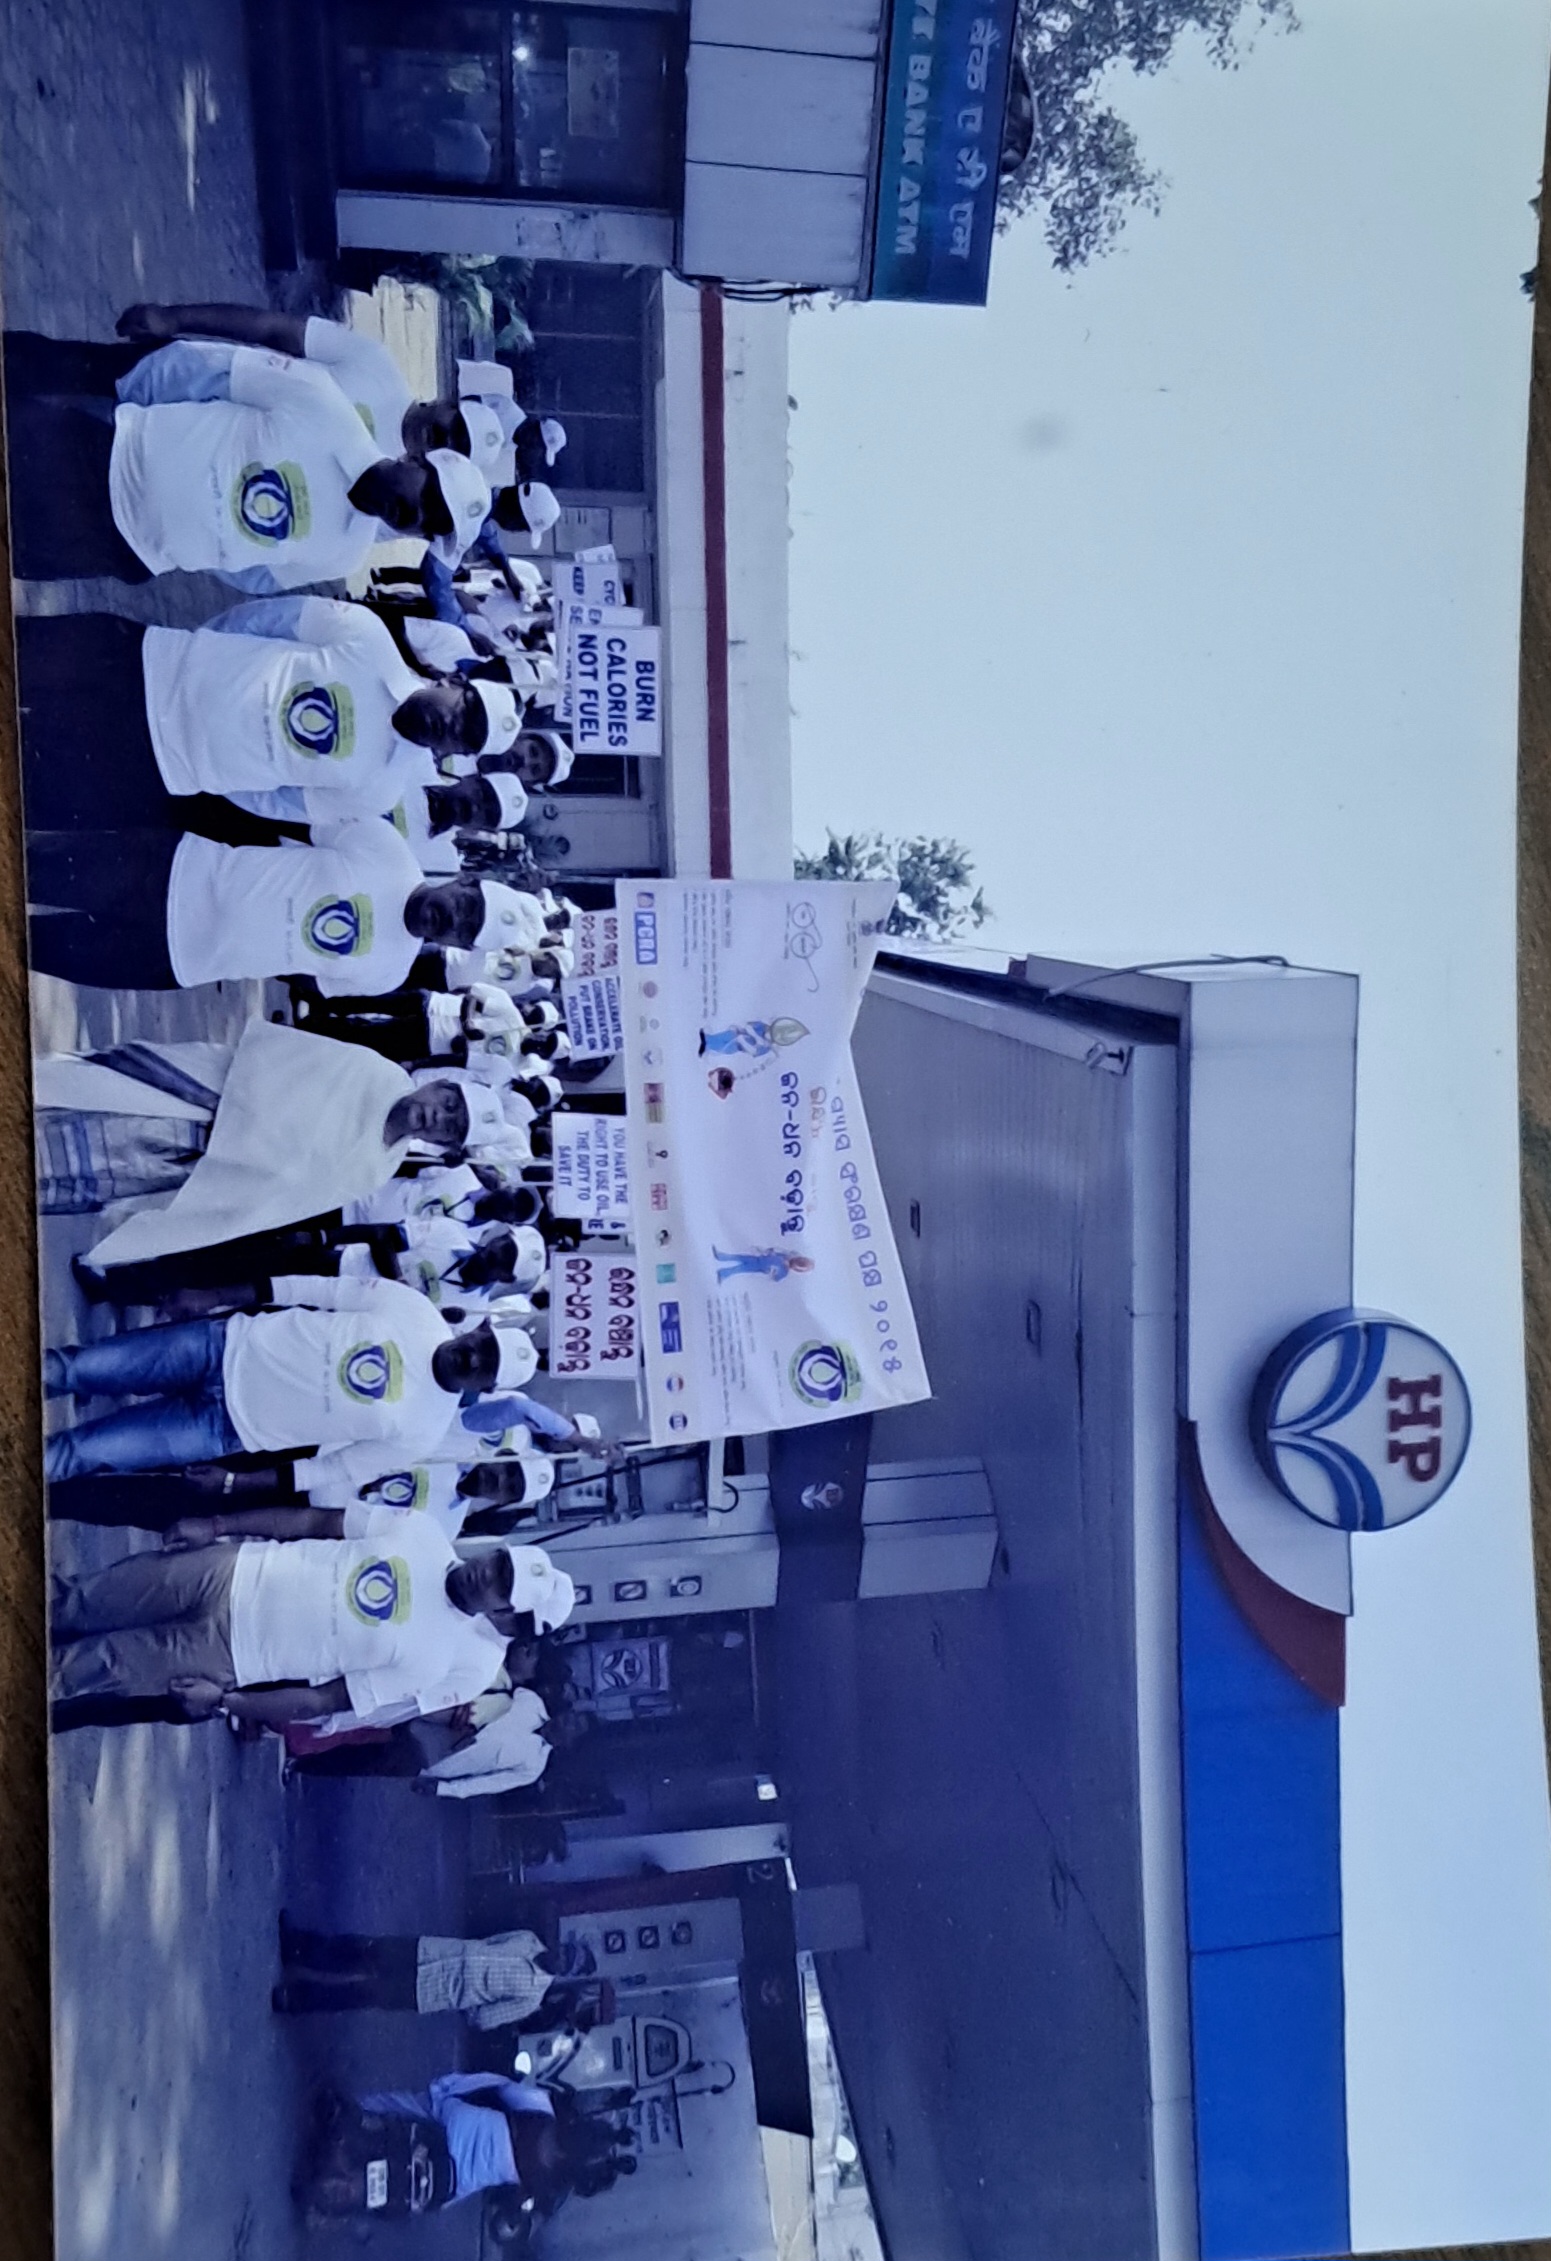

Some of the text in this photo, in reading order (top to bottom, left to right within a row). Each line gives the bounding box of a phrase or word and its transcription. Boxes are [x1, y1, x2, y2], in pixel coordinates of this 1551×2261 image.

[901, 54, 932, 166] BANK
[894, 177, 920, 254] ATM
[578, 634, 598, 681] NOT
[578, 688, 600, 742] FUEL
[606, 638, 628, 747] CALORIES
[635, 660, 656, 722] BURN
[637, 914, 656, 962] PCRA
[568, 996, 582, 1046] POLLUTION
[580, 985, 597, 1051] PUT BRAKE ON
[594, 1118, 608, 1150] RIGHT
[780, 1071, 802, 1158] ଜନ-ଧନ
[558, 1145, 572, 1186] SAVE IT
[576, 1130, 591, 1201] THE DUTY TO
[596, 1153, 608, 1168] TO
[596, 1170, 610, 1192] USE
[612, 1127, 628, 1204] YOU HAVE THE
[838, 1161, 872, 1241] ସଂରକ୍ଷଣ
[858, 1250, 883, 1288] ପକ୍ଷ
[565, 1258, 593, 1321] ଜନ-ଧନ
[608, 1266, 636, 1309] ଇନ୍ଧନ
[1388, 1374, 1442, 1482] HP
